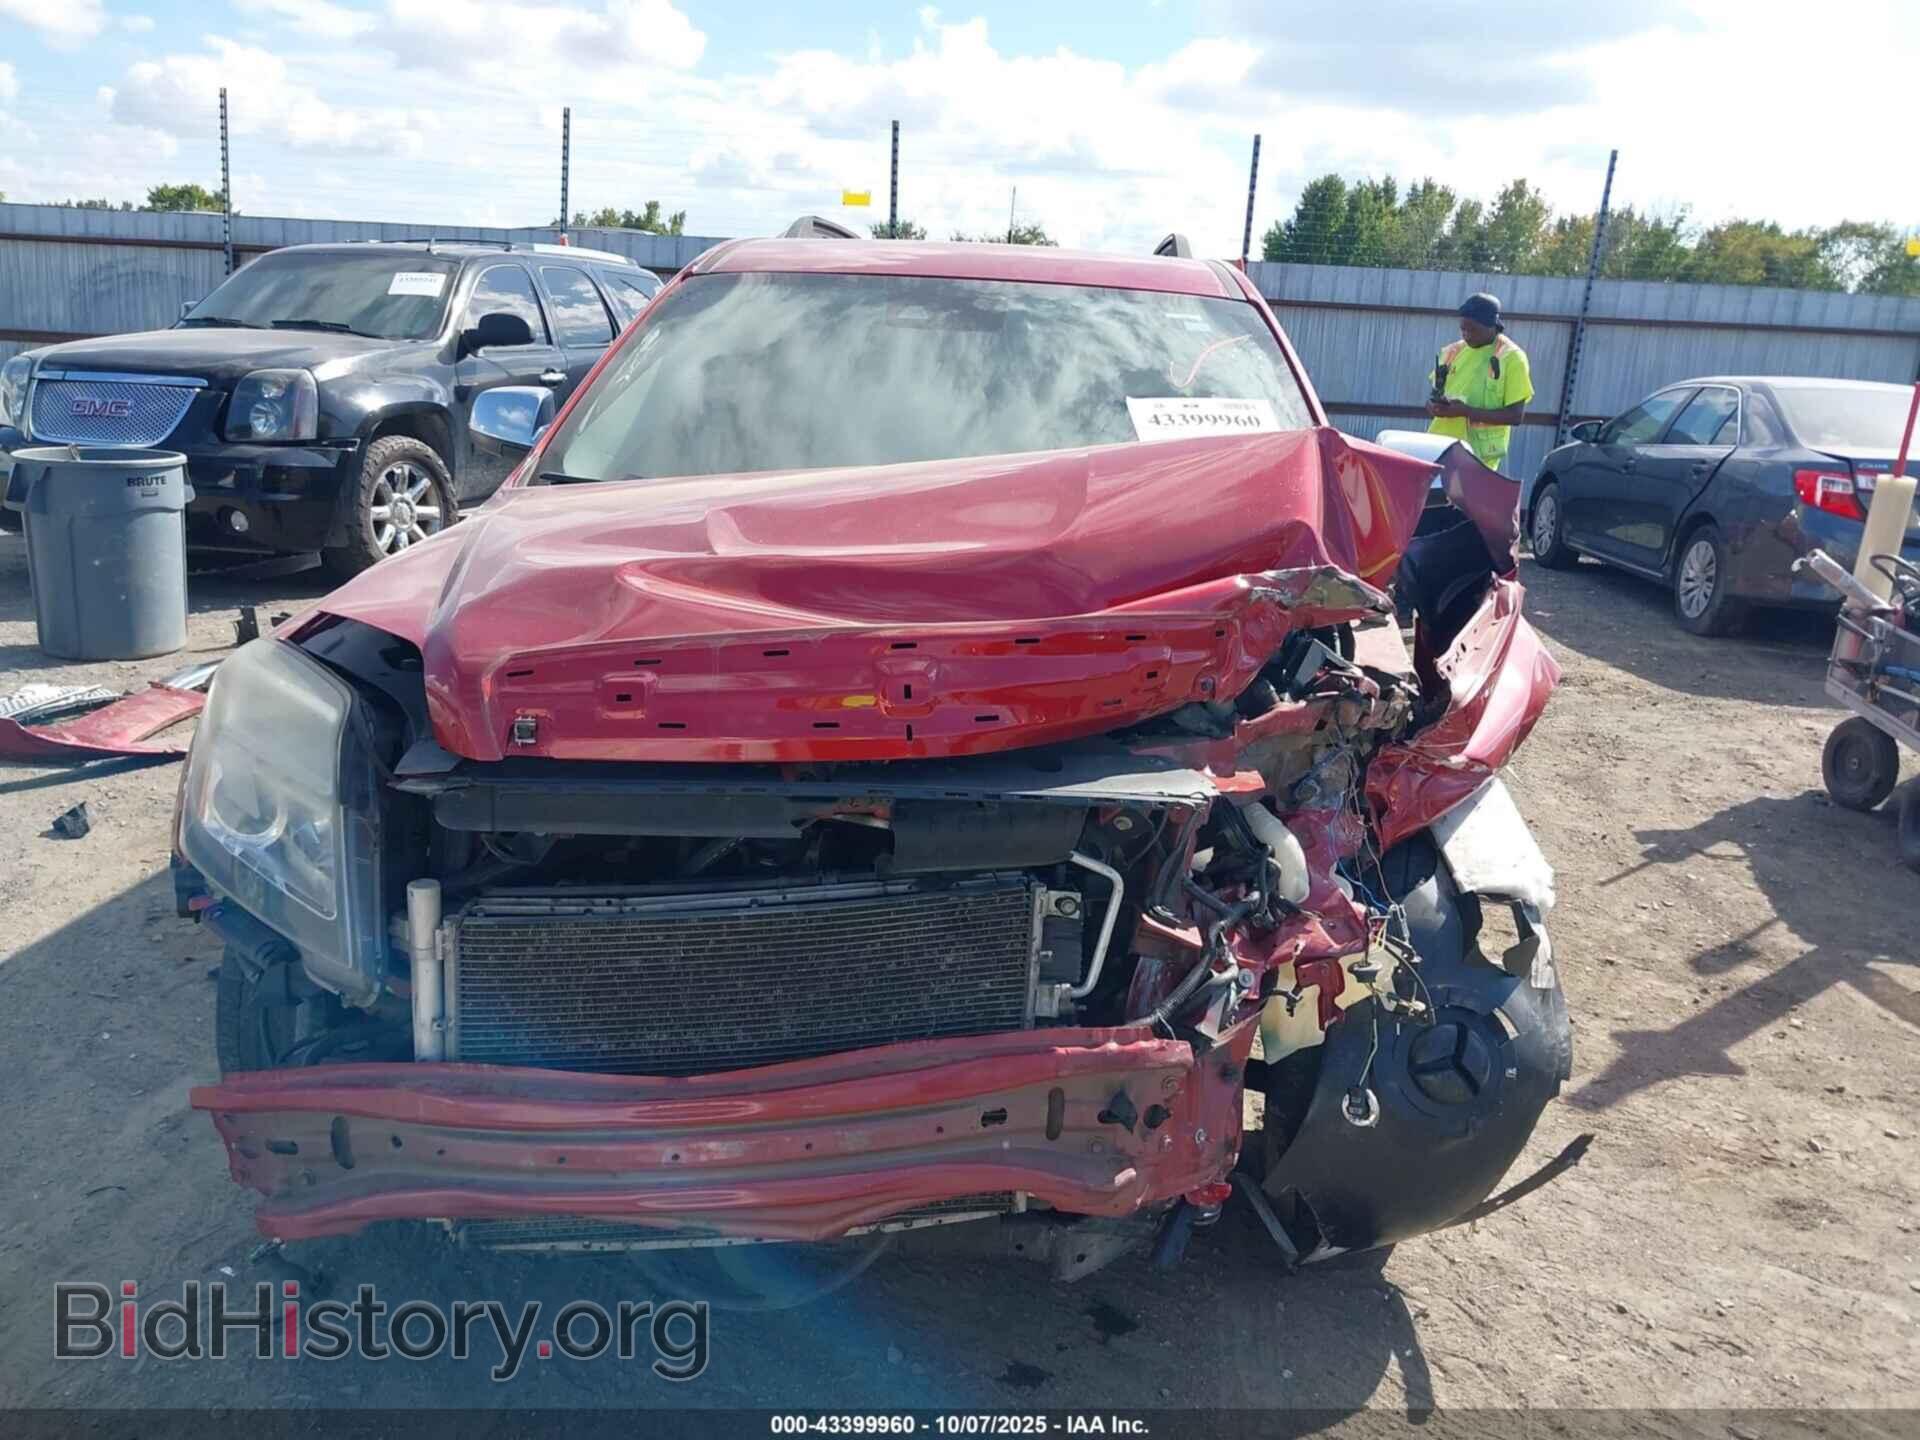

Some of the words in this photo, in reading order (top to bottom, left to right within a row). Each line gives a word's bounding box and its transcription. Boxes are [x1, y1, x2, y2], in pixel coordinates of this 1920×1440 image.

[71, 400, 128, 416] GMC
[1147, 413, 1261, 428] 43399960
[127, 475, 168, 487] BRUTE
